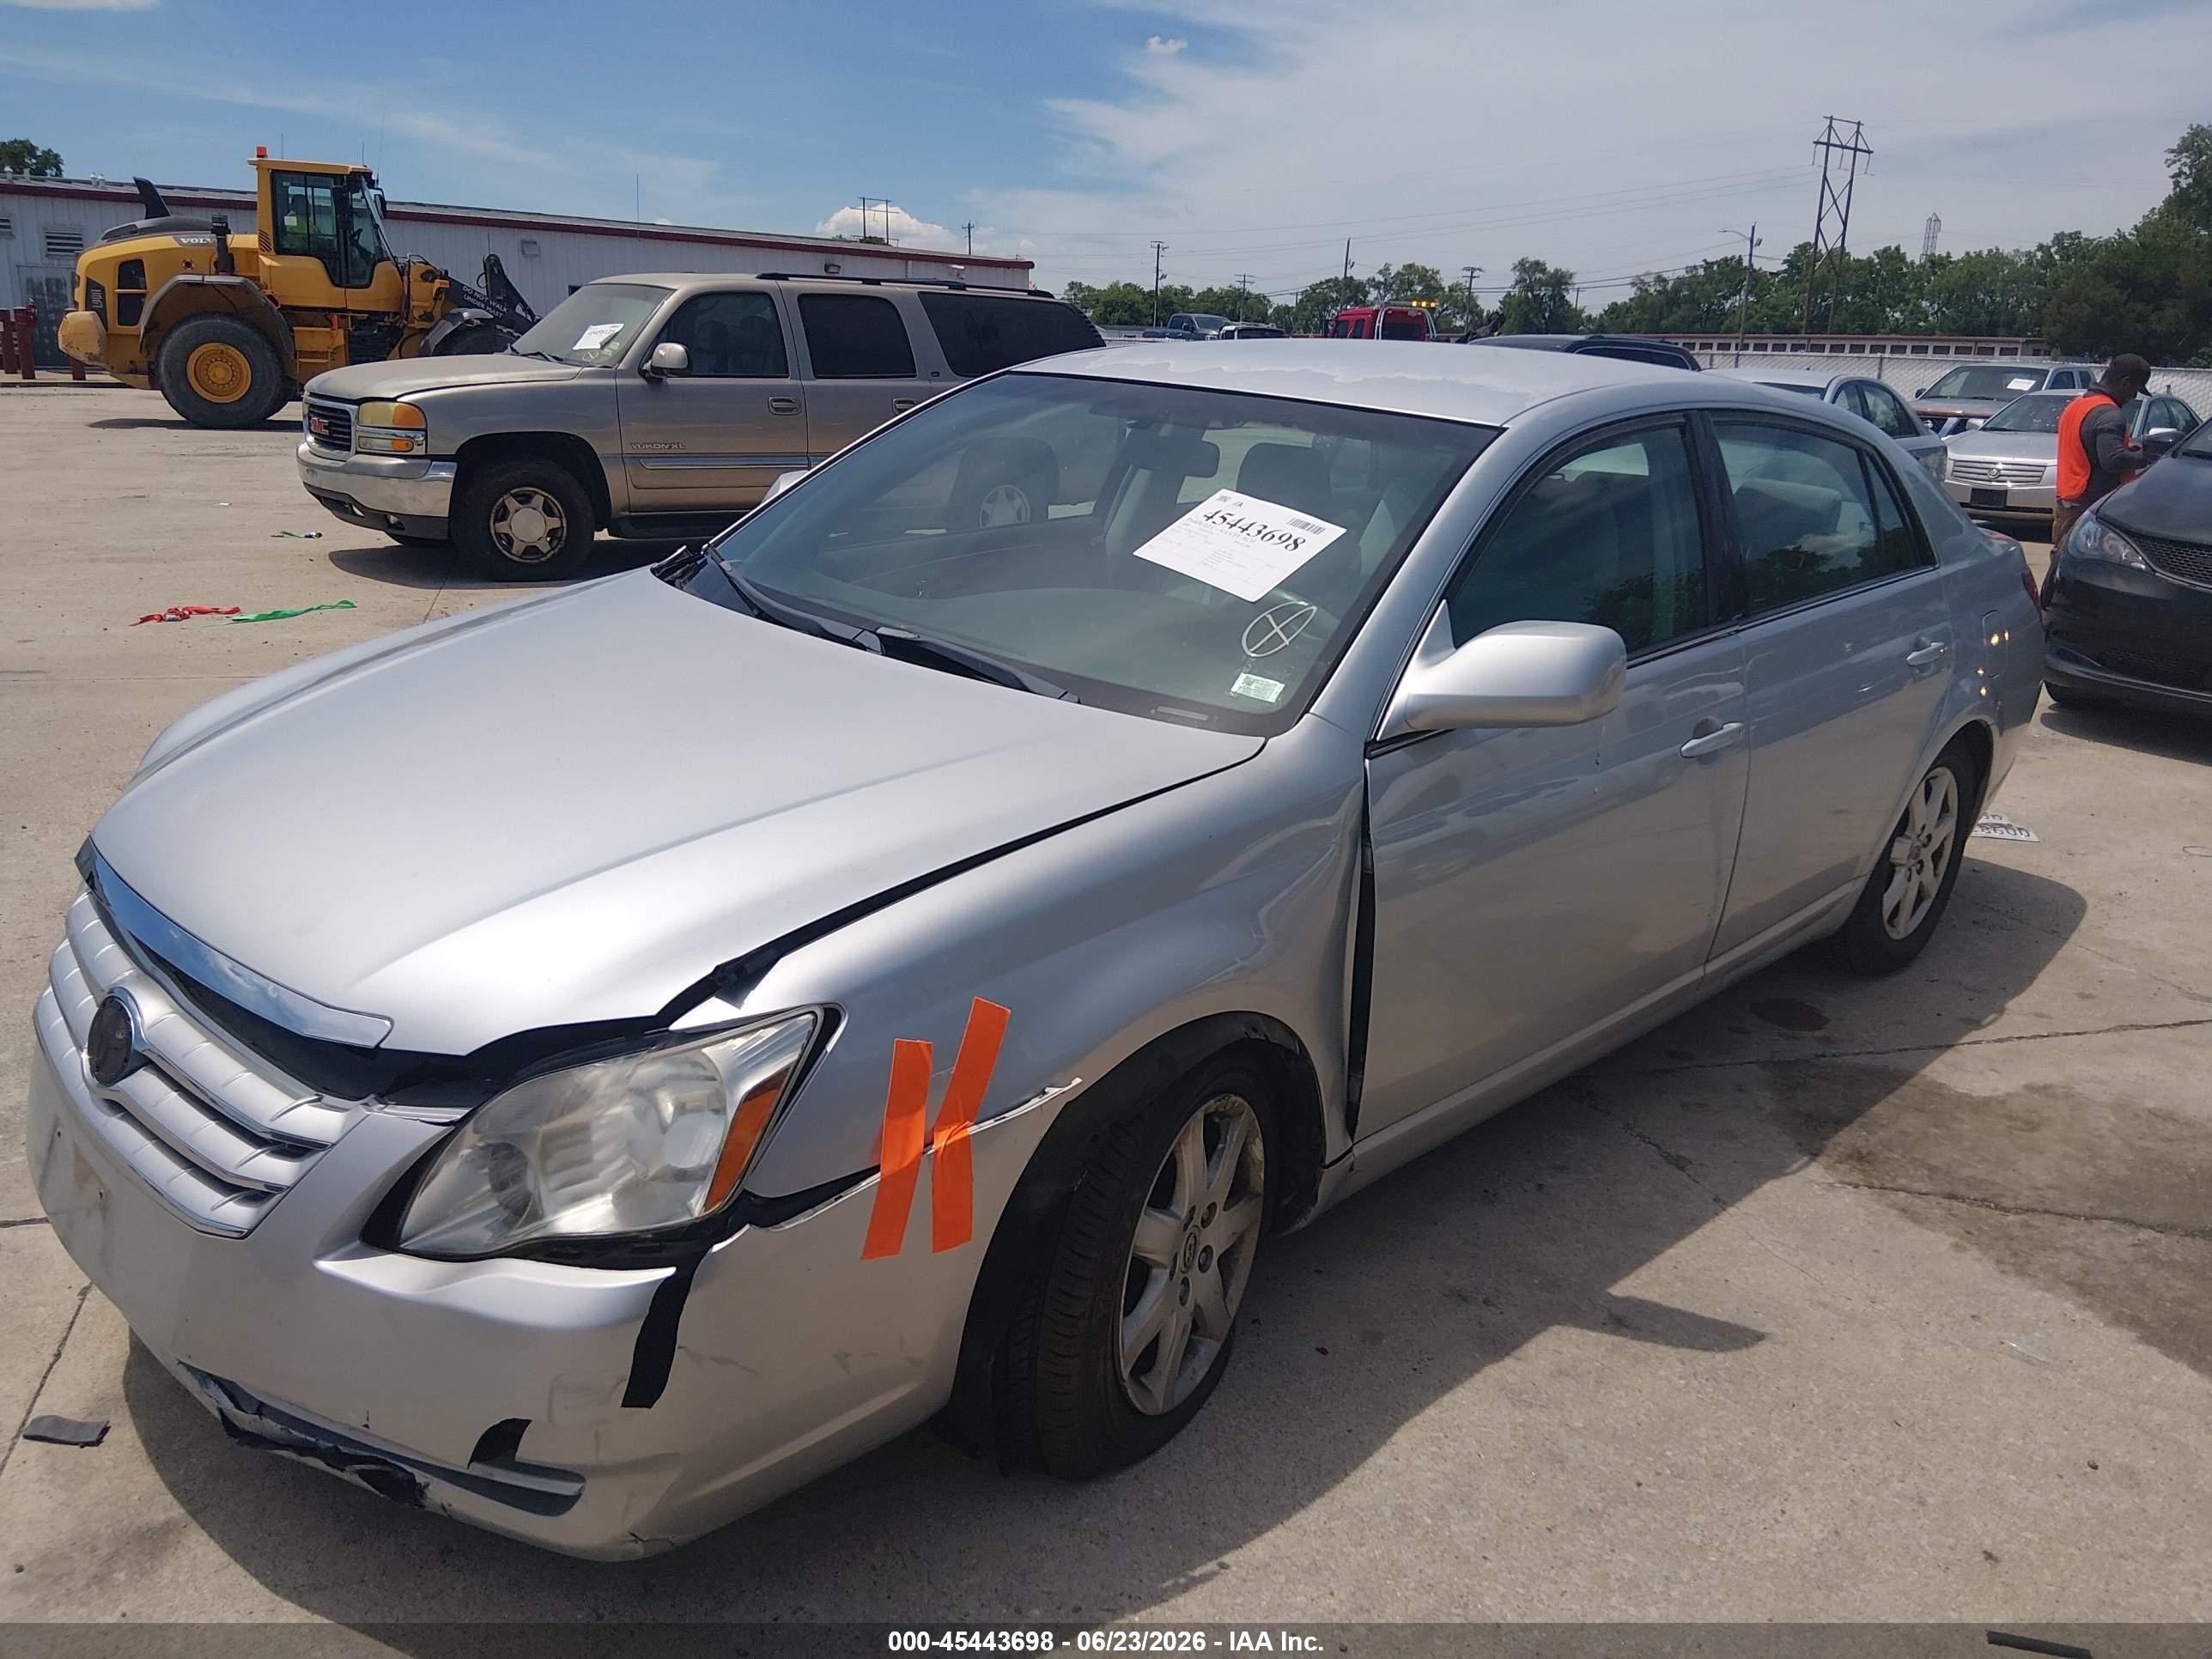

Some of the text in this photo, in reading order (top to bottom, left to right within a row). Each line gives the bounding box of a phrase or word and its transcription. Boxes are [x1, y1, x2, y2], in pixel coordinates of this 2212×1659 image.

[462, 285, 474, 294] DO
[473, 292, 489, 302] NOT
[464, 294, 485, 309] UNDER
[1203, 510, 1306, 551] 45443698
